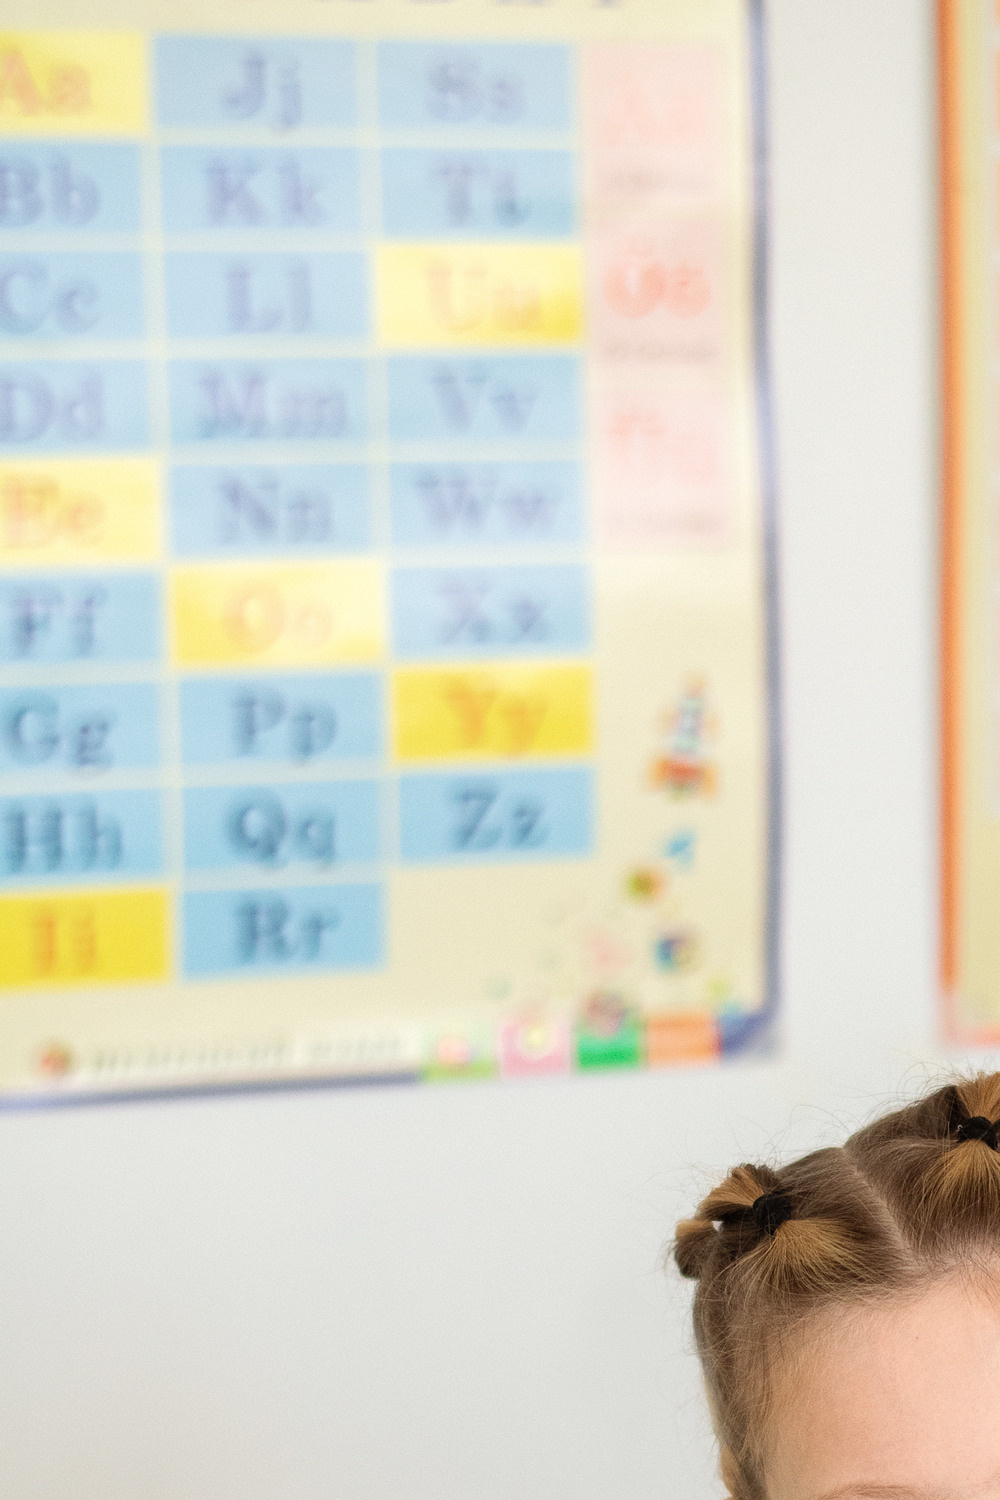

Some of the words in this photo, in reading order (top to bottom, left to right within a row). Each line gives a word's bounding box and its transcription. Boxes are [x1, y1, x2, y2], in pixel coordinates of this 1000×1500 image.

[219, 50, 305, 134] Jj
[0, 157, 100, 227] Bb
[204, 158, 328, 228] Kk
[0, 261, 100, 334] Cc
[0, 369, 106, 442] Dd
[198, 367, 349, 440] Mm
[429, 363, 538, 433] Vv
[216, 475, 334, 544] Nn
[415, 469, 560, 538] Ww
[10, 586, 106, 657] Ff
[437, 580, 551, 645] Xx
[6, 694, 112, 772] Gg
[231, 689, 338, 766] Pp
[446, 678, 547, 756] Yy
[3, 806, 122, 874] Hh
[225, 790, 338, 870] Qq
[451, 790, 549, 850] Zz
[236, 903, 338, 964] Rr
